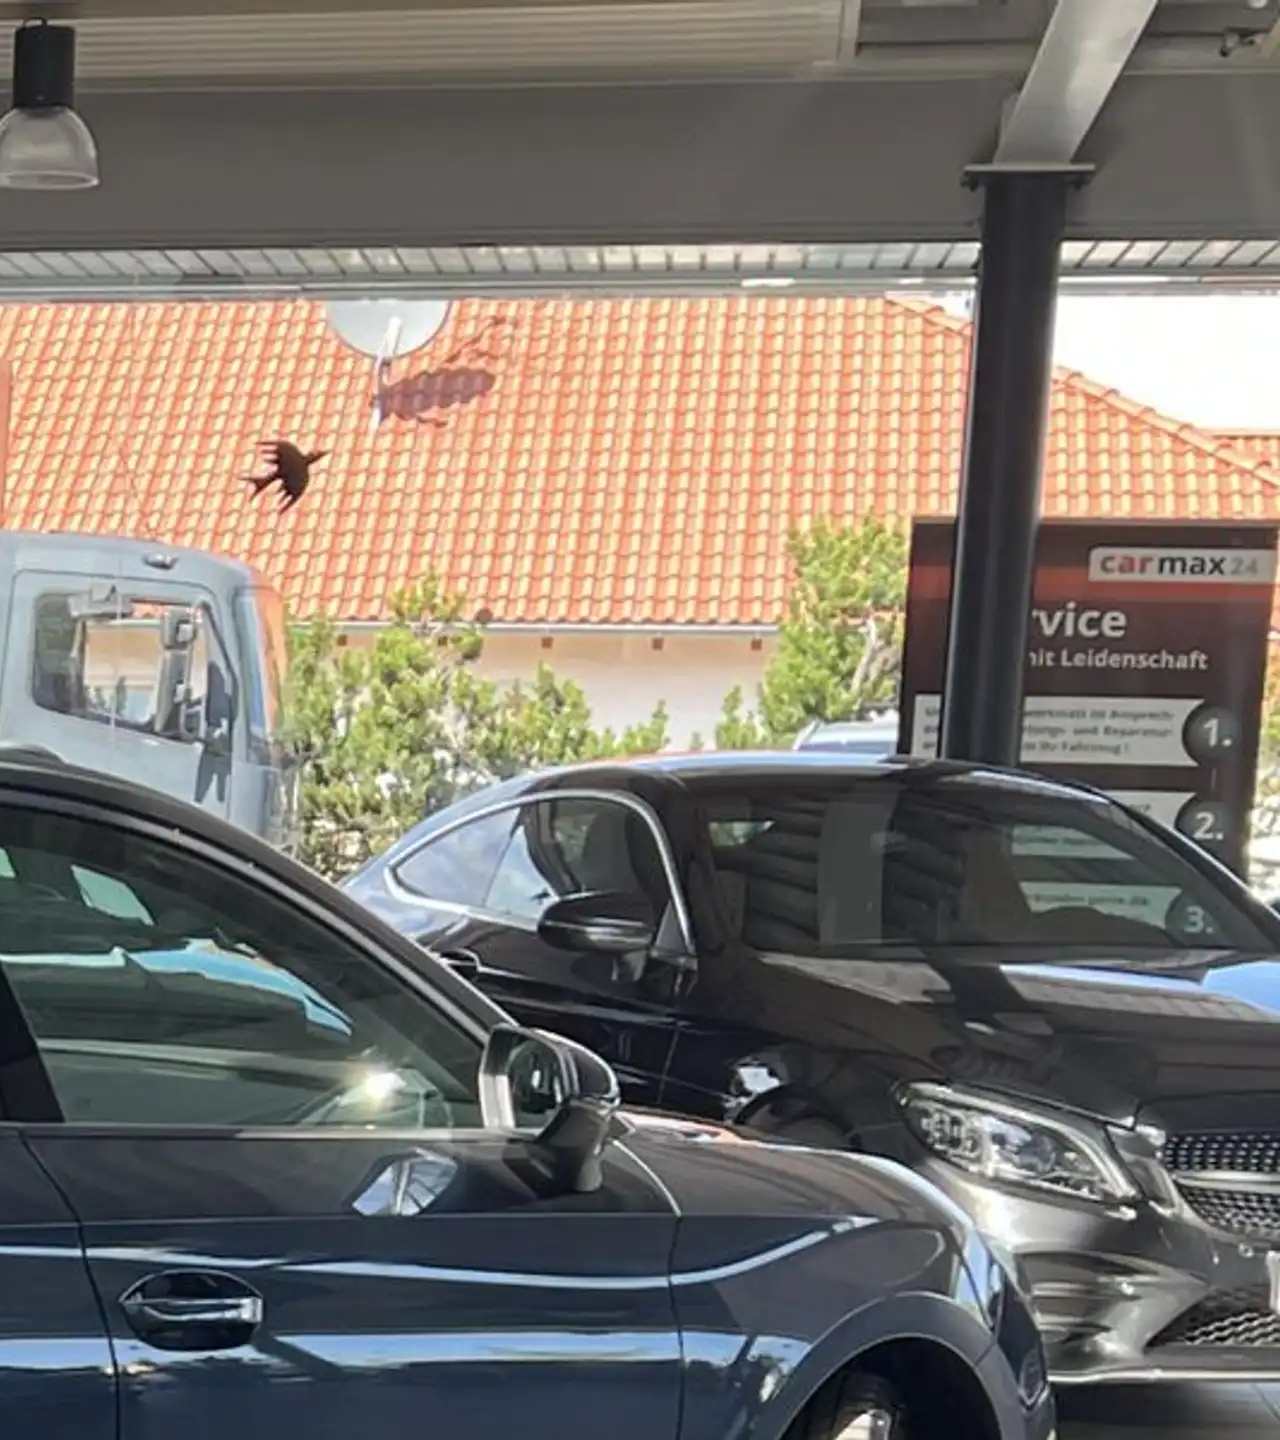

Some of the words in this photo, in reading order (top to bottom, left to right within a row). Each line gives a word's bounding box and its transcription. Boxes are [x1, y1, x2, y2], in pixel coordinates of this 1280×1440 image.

[1100, 554, 1258, 576] carmax24
[1032, 601, 1128, 637] vice
[1061, 649, 1209, 670] Leidenschaft
[1204, 718, 1232, 747] 1.
[1194, 811, 1224, 840] 2.
